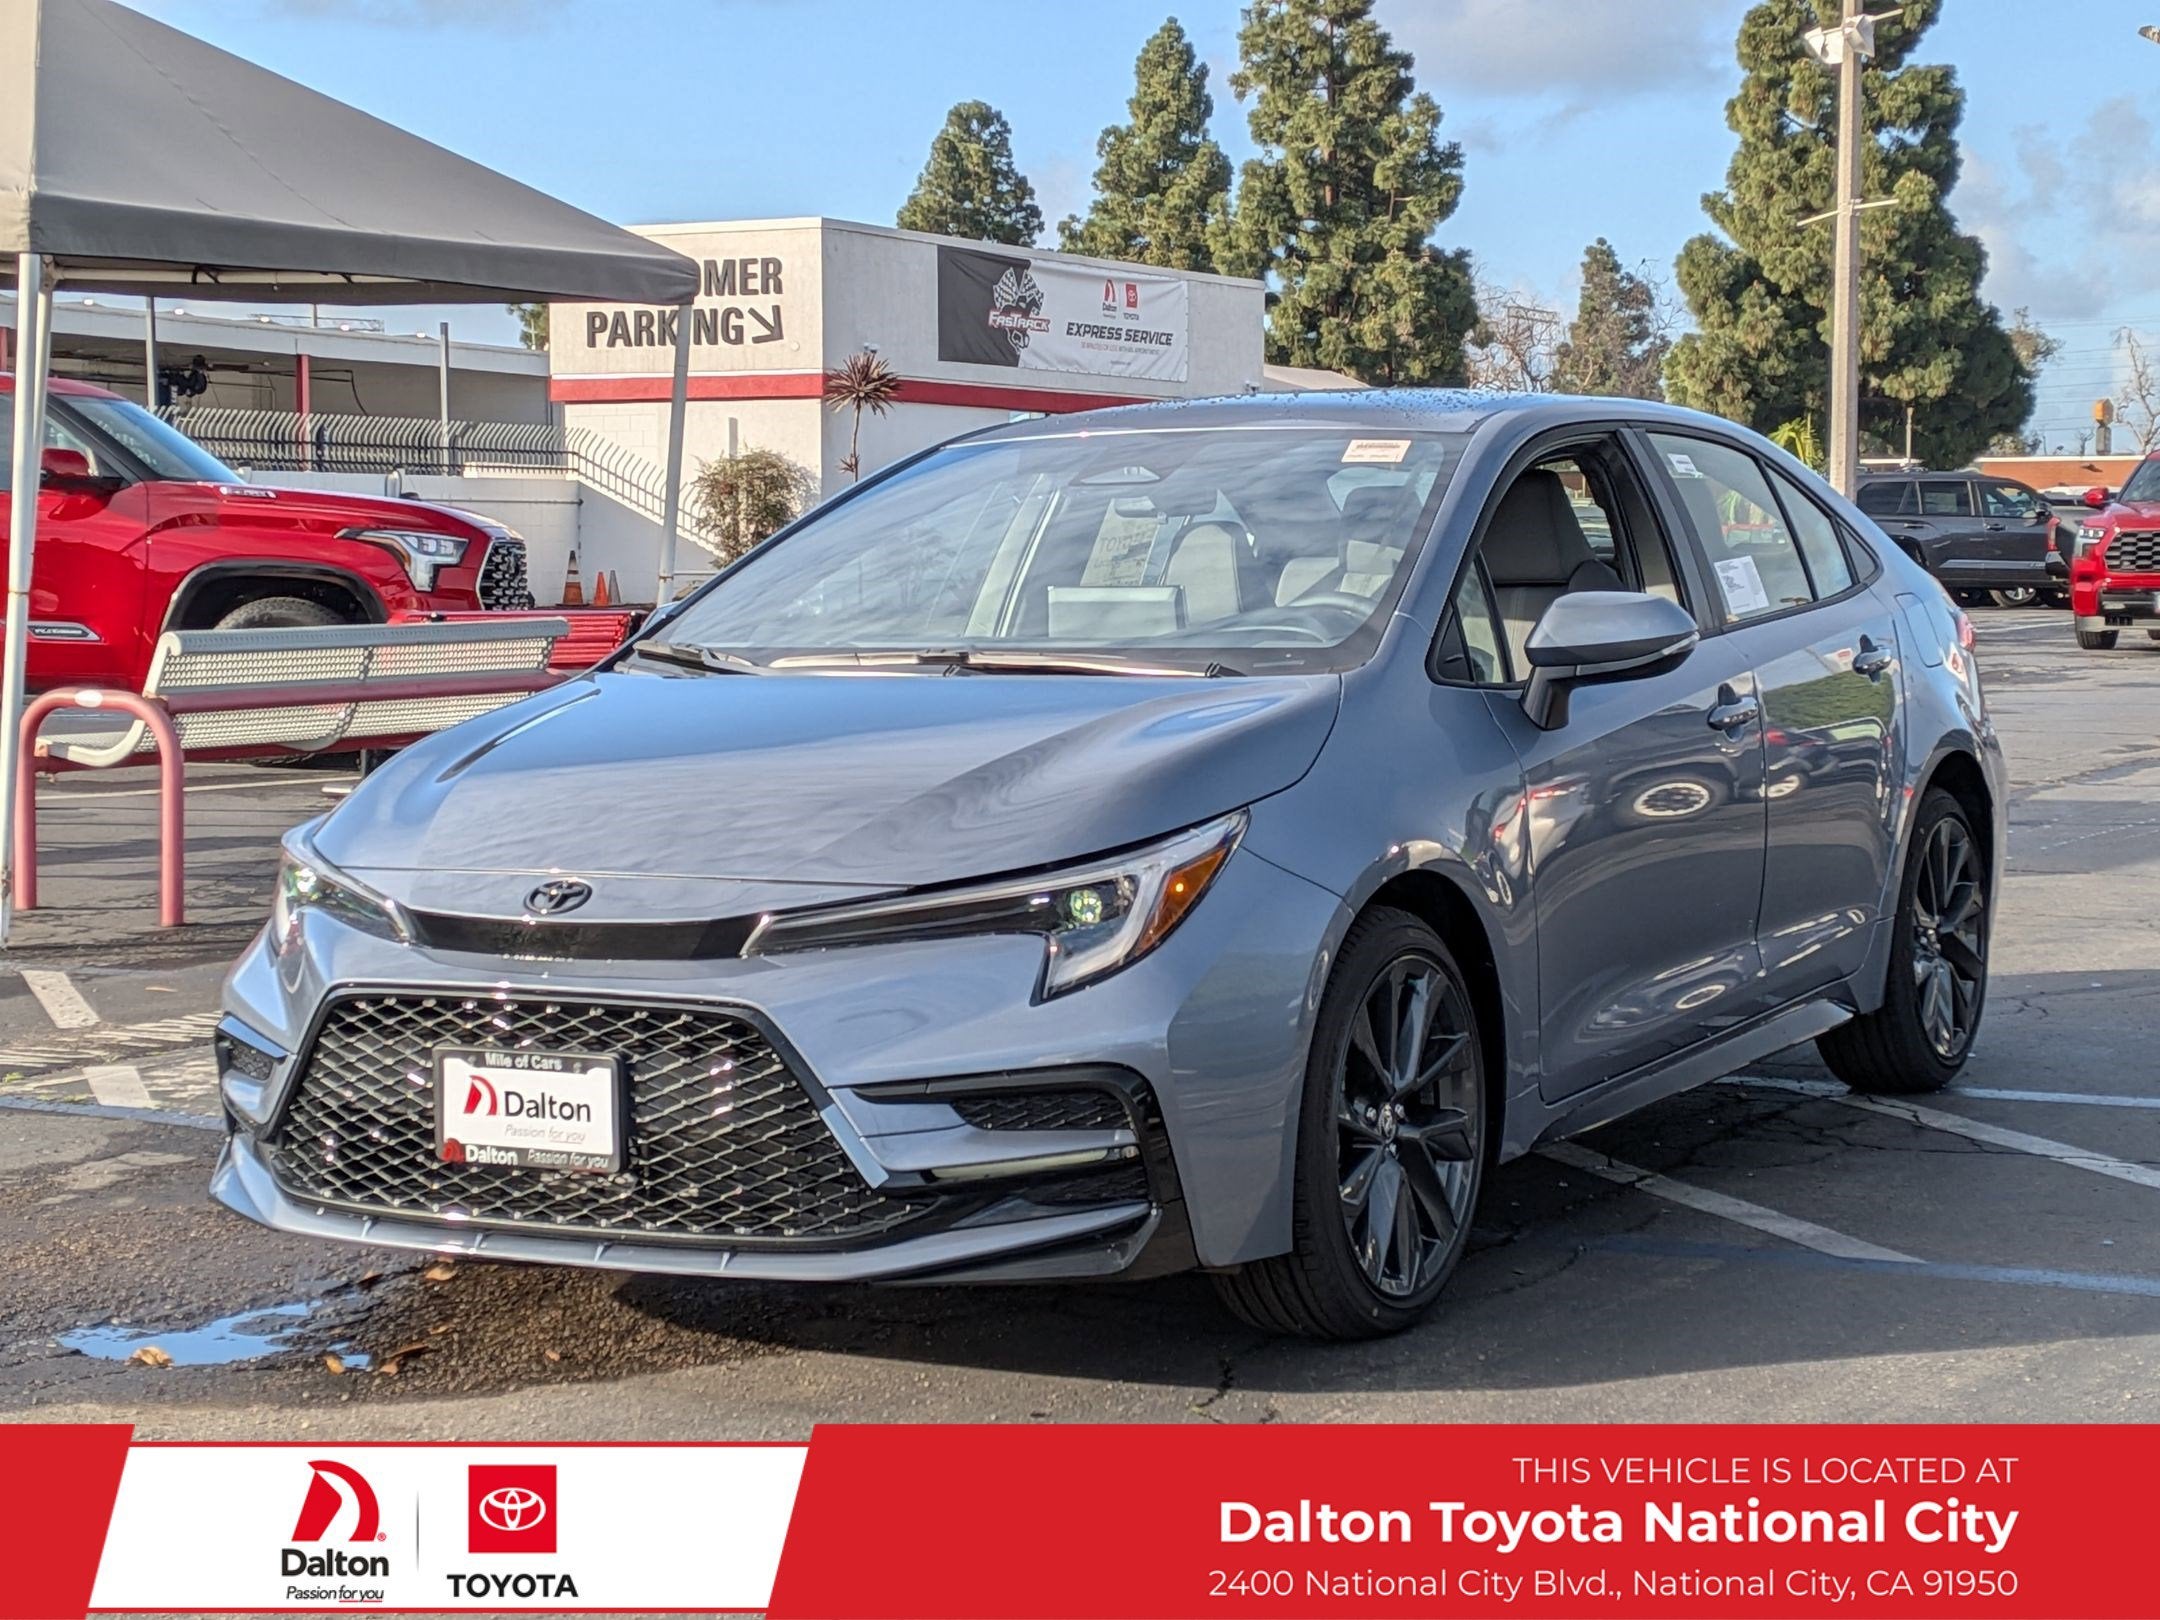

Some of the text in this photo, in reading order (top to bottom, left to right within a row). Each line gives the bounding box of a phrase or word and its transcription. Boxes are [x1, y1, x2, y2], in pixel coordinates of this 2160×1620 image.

[695, 257, 783, 297] MER
[586, 306, 745, 348] PARKNG
[1066, 321, 1174, 346] EXPRESS SERVICE
[485, 1053, 563, 1071] Mile of Cars
[504, 1091, 592, 1122] Dalton
[505, 1124, 586, 1142] Passion for you
[466, 1145, 518, 1166] Dalton
[527, 1149, 609, 1169] Passion for you
